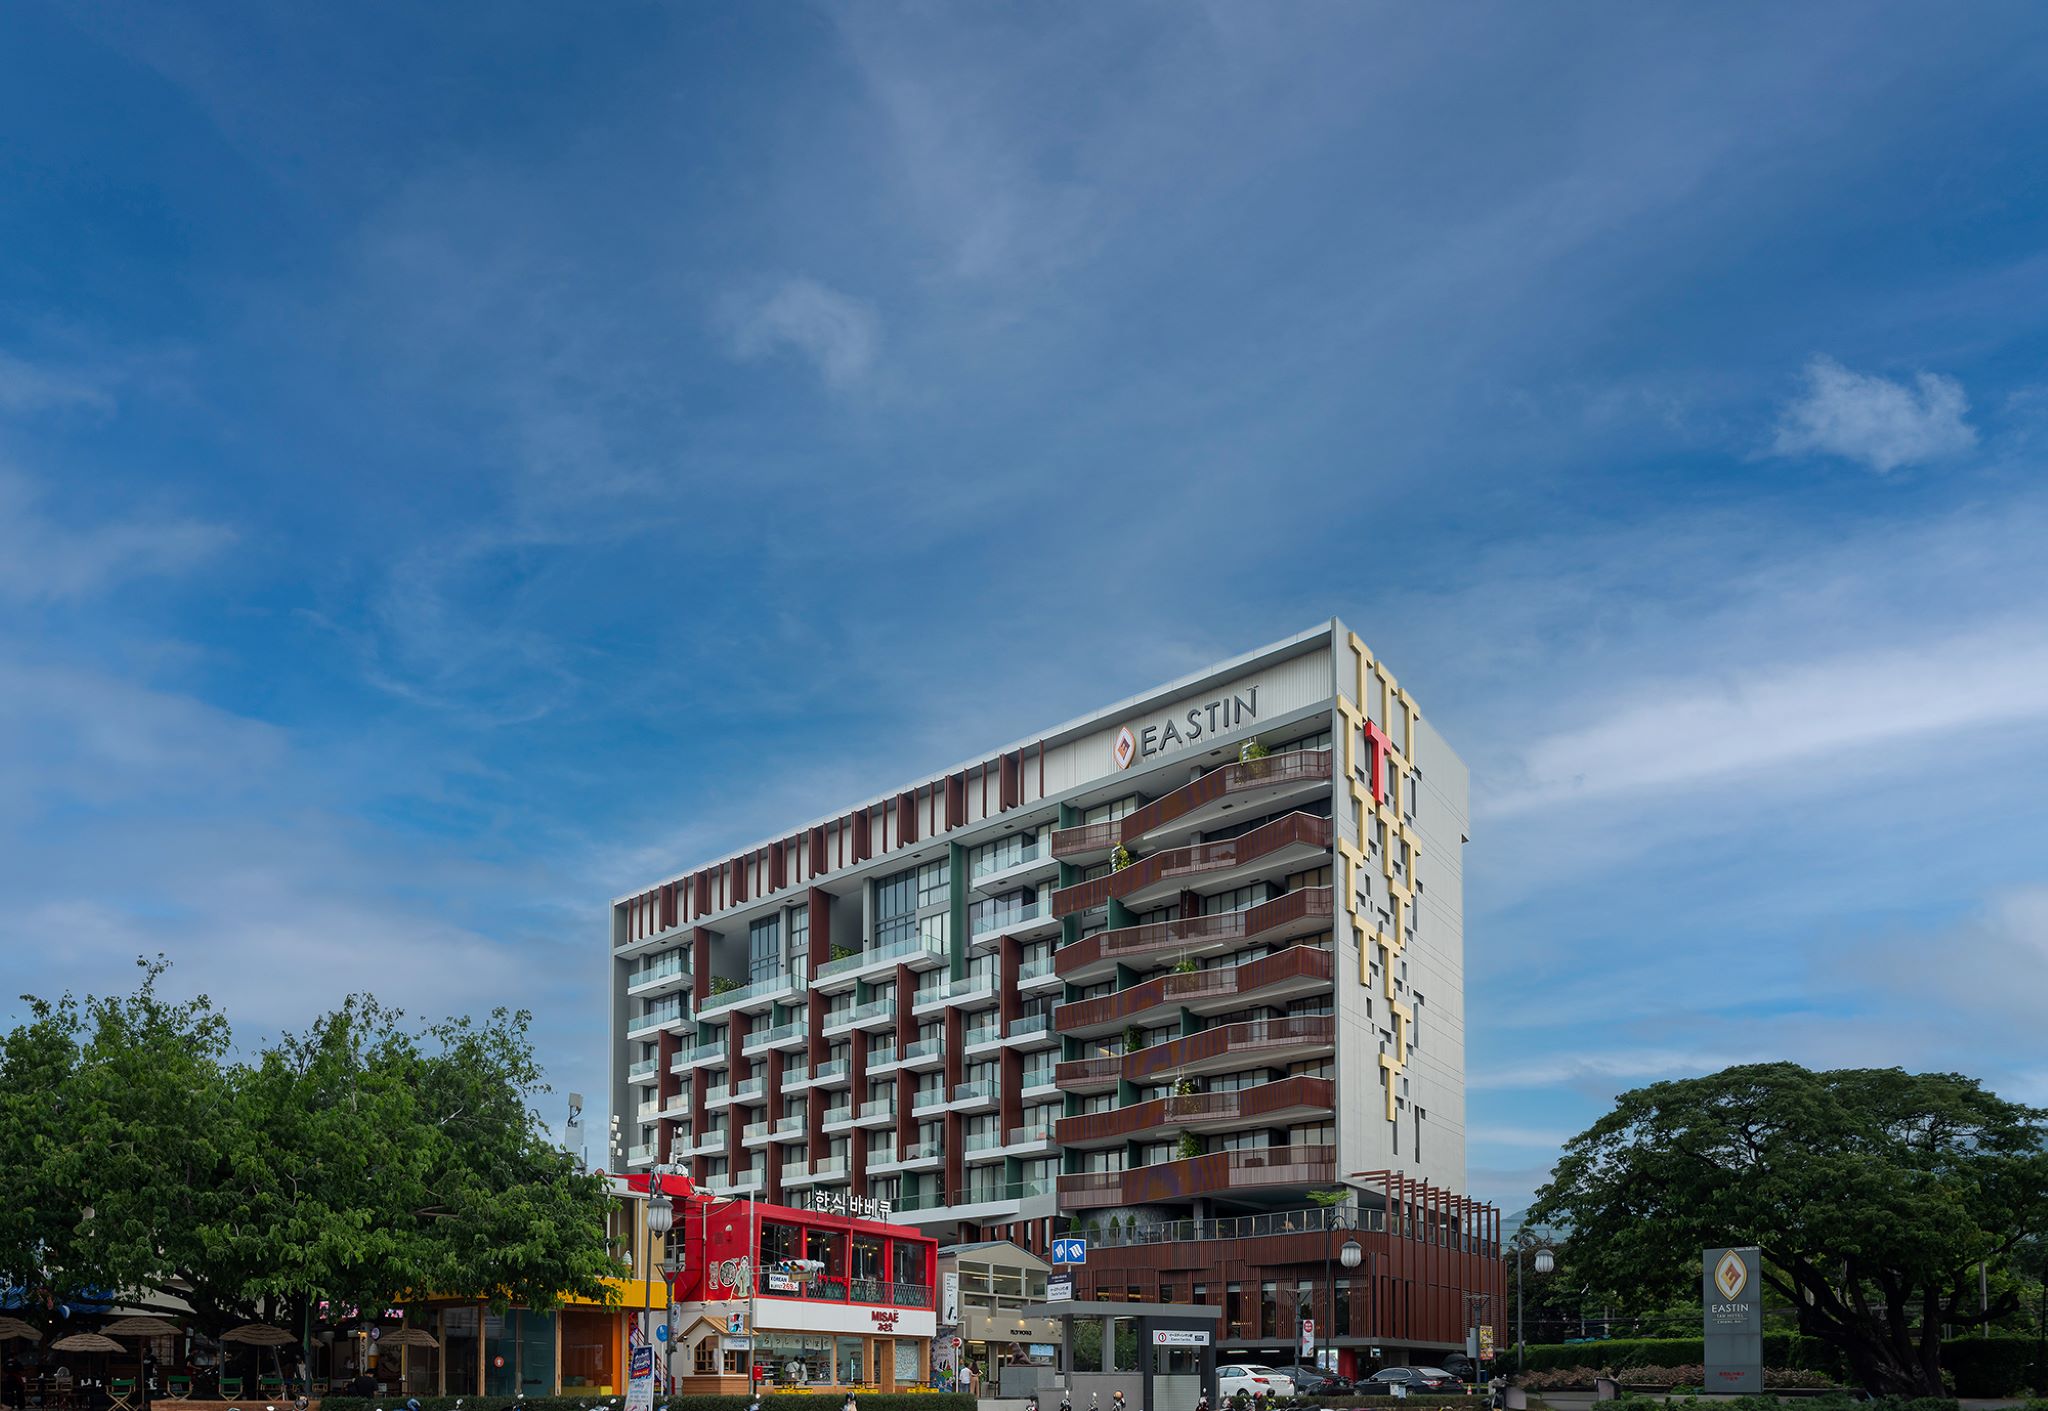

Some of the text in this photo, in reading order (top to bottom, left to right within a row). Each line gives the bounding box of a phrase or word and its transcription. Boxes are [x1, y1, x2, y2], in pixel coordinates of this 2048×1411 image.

[1141, 684, 1259, 757] EASTIN
[816, 1190, 892, 1220] 한식 바베큐
[1711, 1303, 1749, 1313] EASTIN
